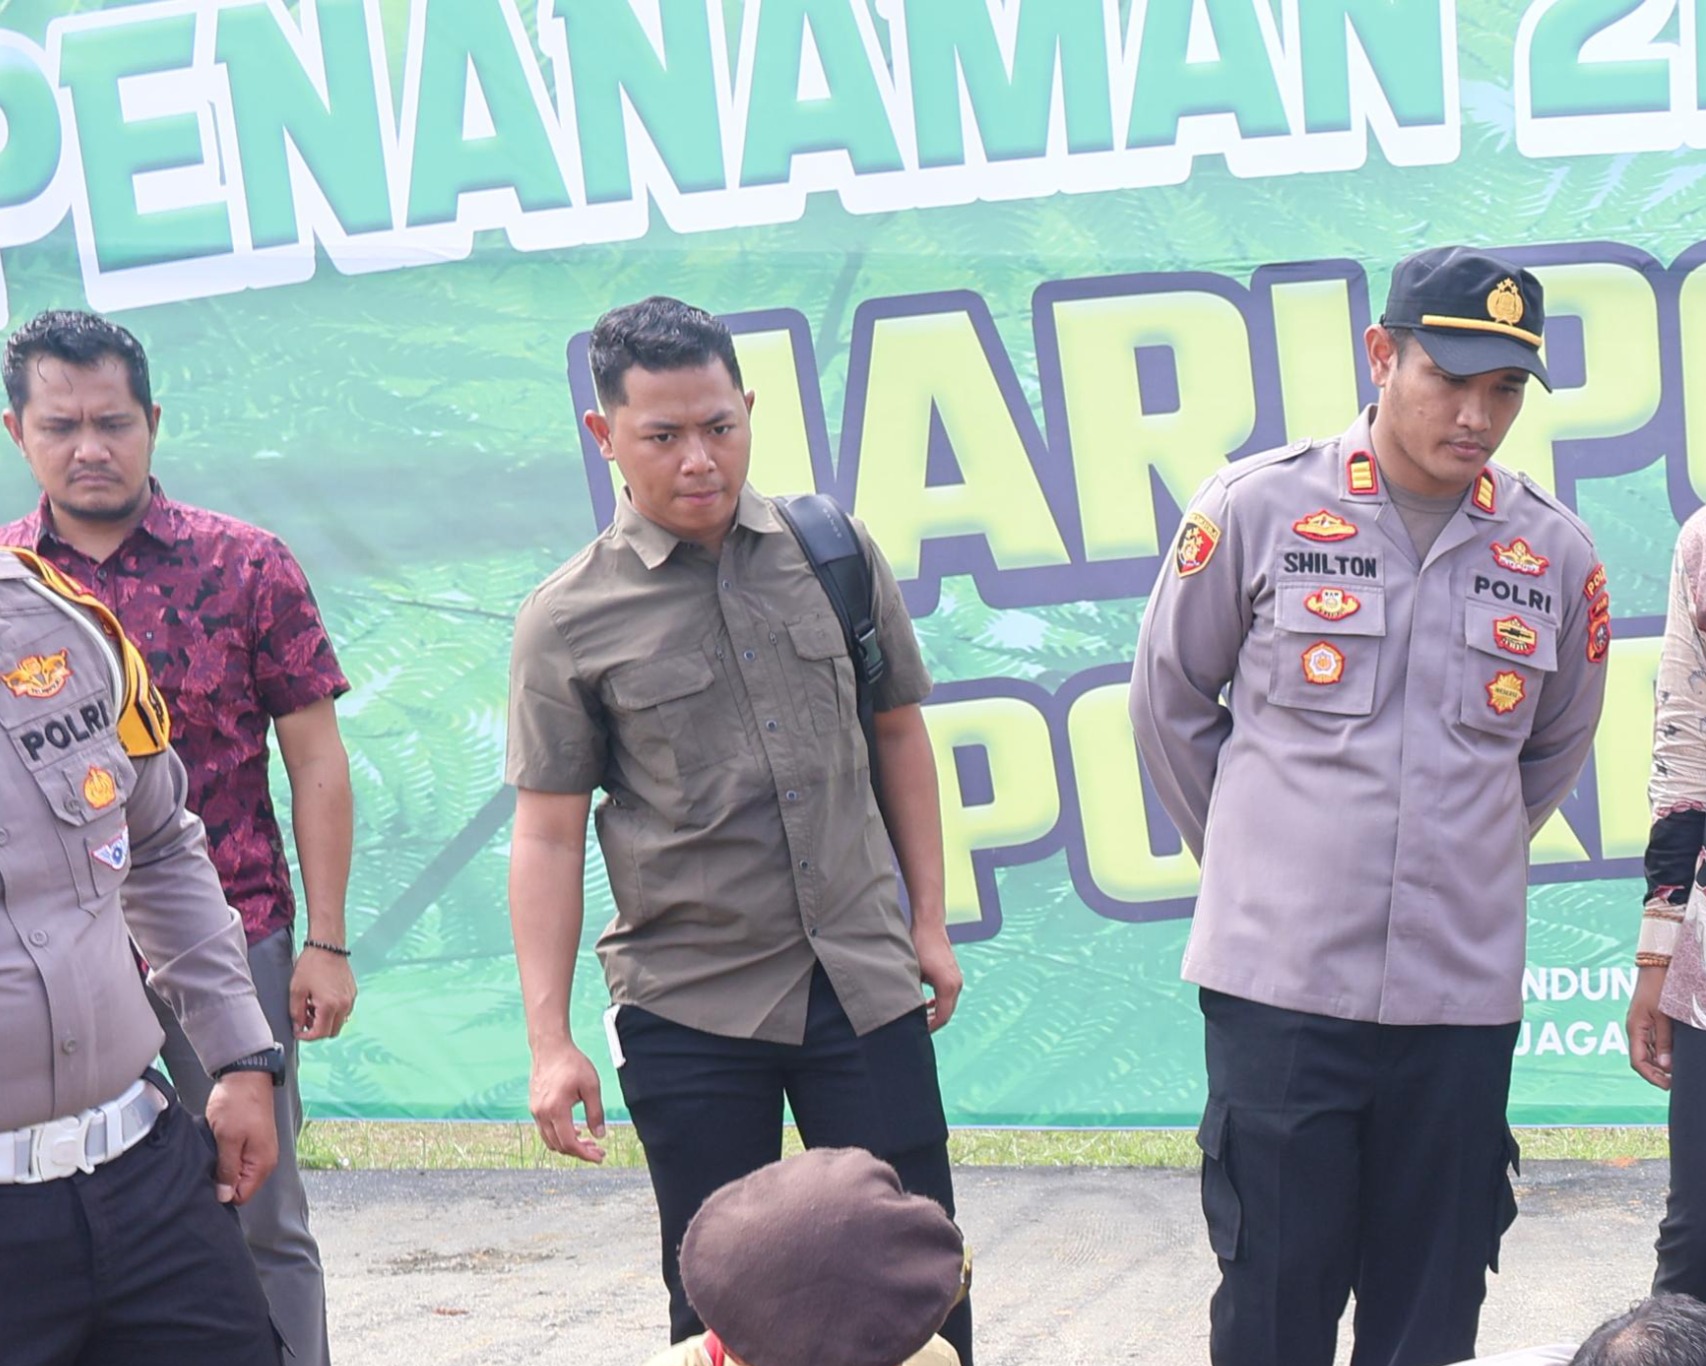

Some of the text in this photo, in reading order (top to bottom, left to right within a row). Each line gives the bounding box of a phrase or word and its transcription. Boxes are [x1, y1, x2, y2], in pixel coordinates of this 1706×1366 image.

[1284, 552, 1377, 578] SHILTON
[1474, 576, 1552, 614] POLRI
[20, 700, 110, 761] POLRI
[1521, 967, 1640, 1001] NDUN
